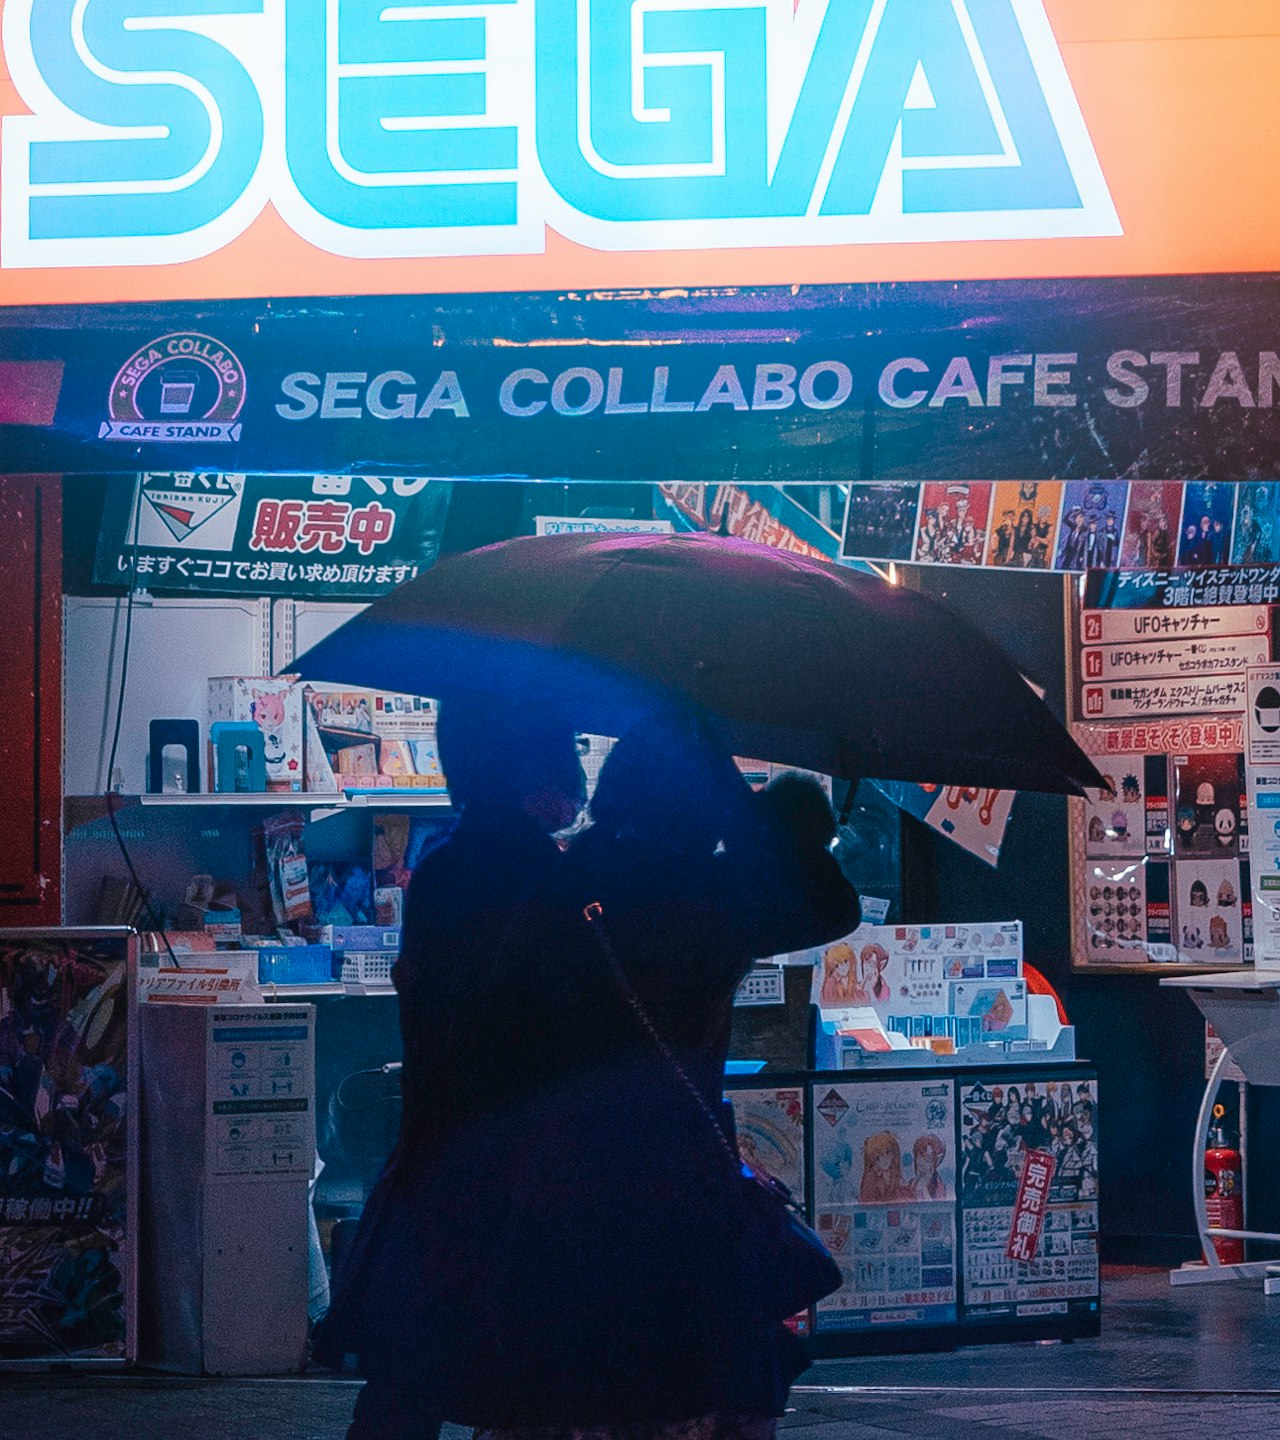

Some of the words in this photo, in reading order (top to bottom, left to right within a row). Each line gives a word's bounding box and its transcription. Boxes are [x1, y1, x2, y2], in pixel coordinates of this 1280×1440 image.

[121, 349, 162, 386] SEGA
[167, 338, 239, 384] COLLABO
[275, 371, 471, 420] SEGA
[499, 358, 853, 417] COLLABO
[878, 351, 1078, 410] CAFE
[120, 426, 160, 437] CAFE
[166, 426, 222, 437] STAND
[249, 498, 396, 556] 販売中
[1134, 616, 1221, 634] UFOキャッチャー
[1110, 651, 1182, 667] UFOキャッチャー
